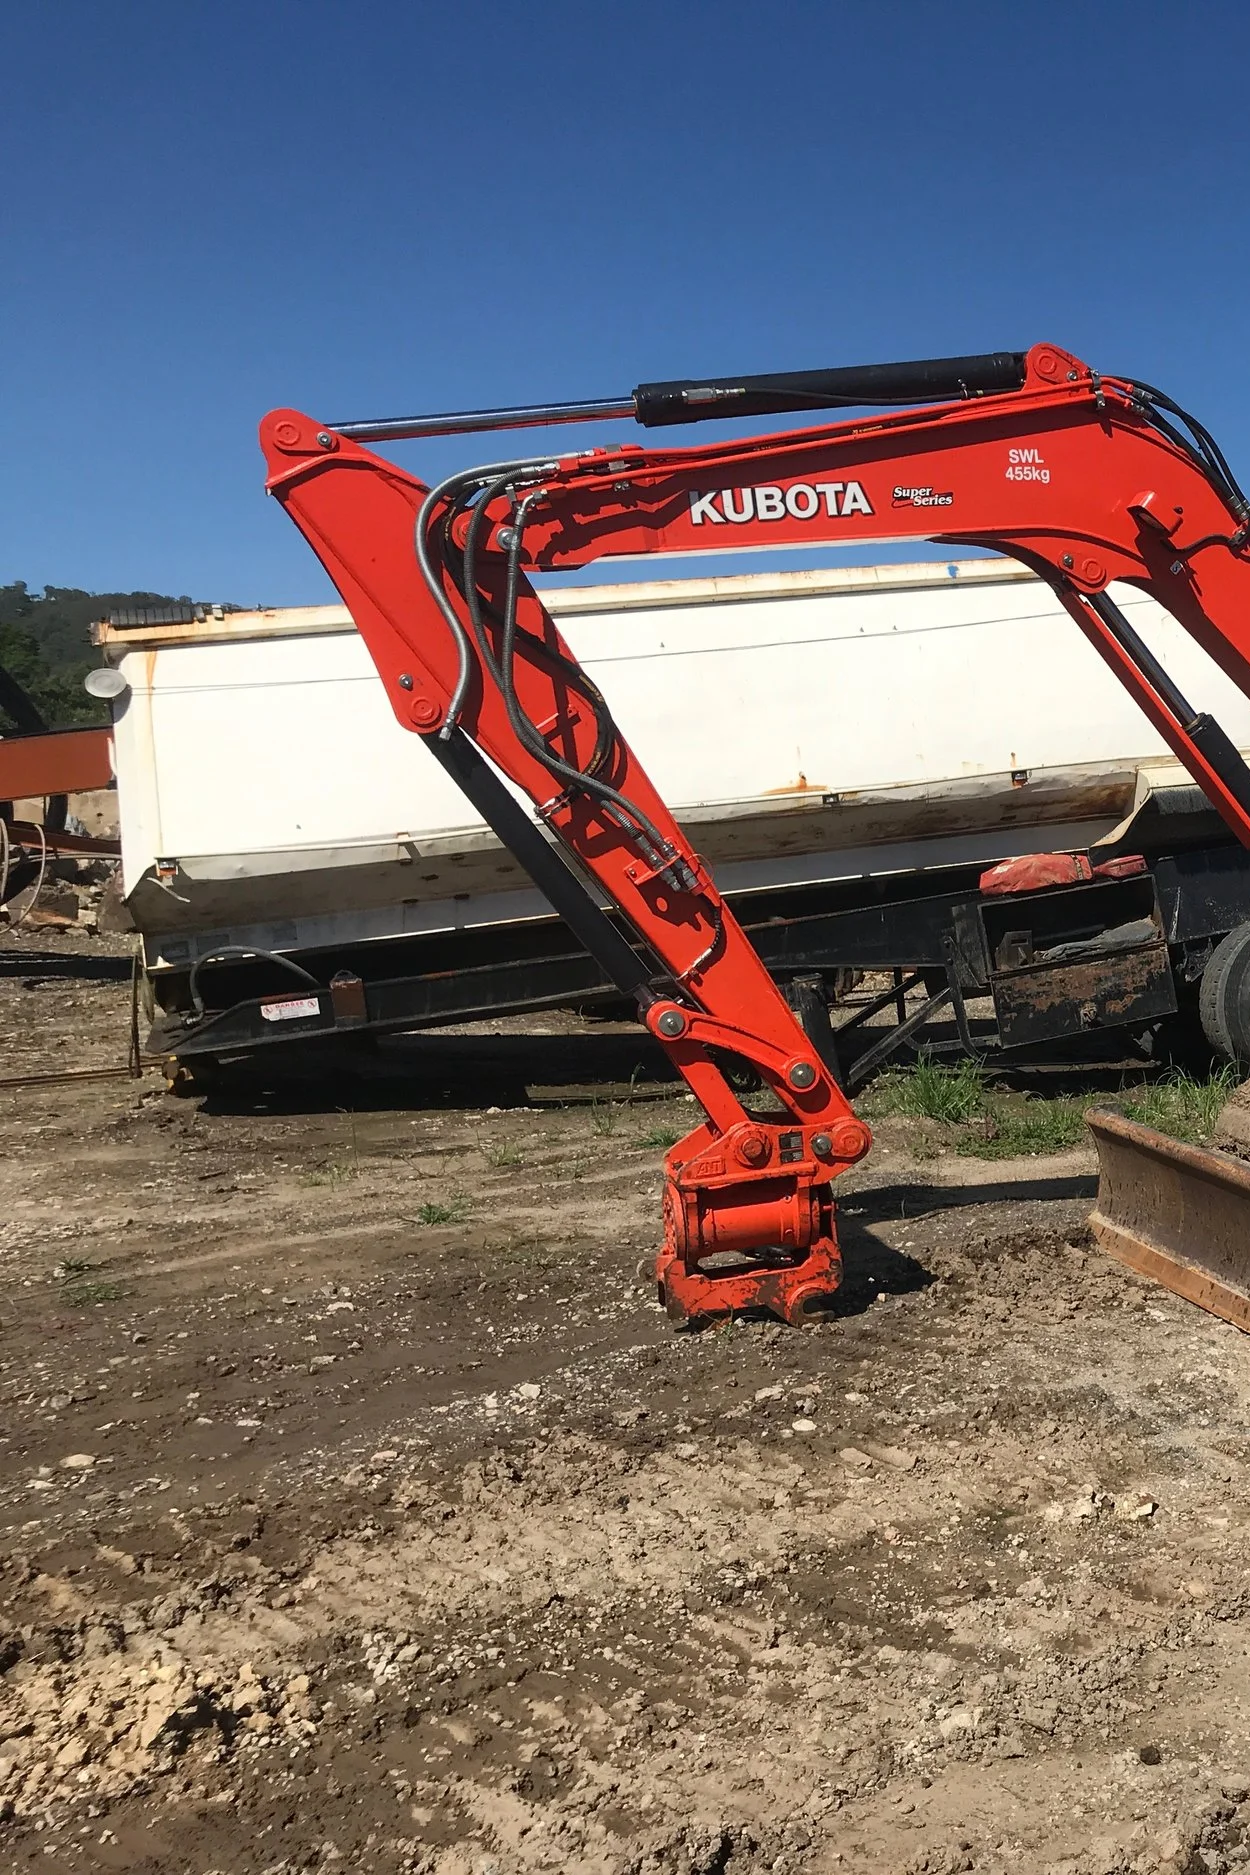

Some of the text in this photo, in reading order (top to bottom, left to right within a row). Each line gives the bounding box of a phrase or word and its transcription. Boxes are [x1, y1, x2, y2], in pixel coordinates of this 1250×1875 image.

[1009, 448, 1044, 464] SWL
[1005, 466, 1050, 484] 455kg
[893, 486, 933, 500] Super
[913, 494, 953, 506] Series
[688, 481, 873, 525] KUBOTA
